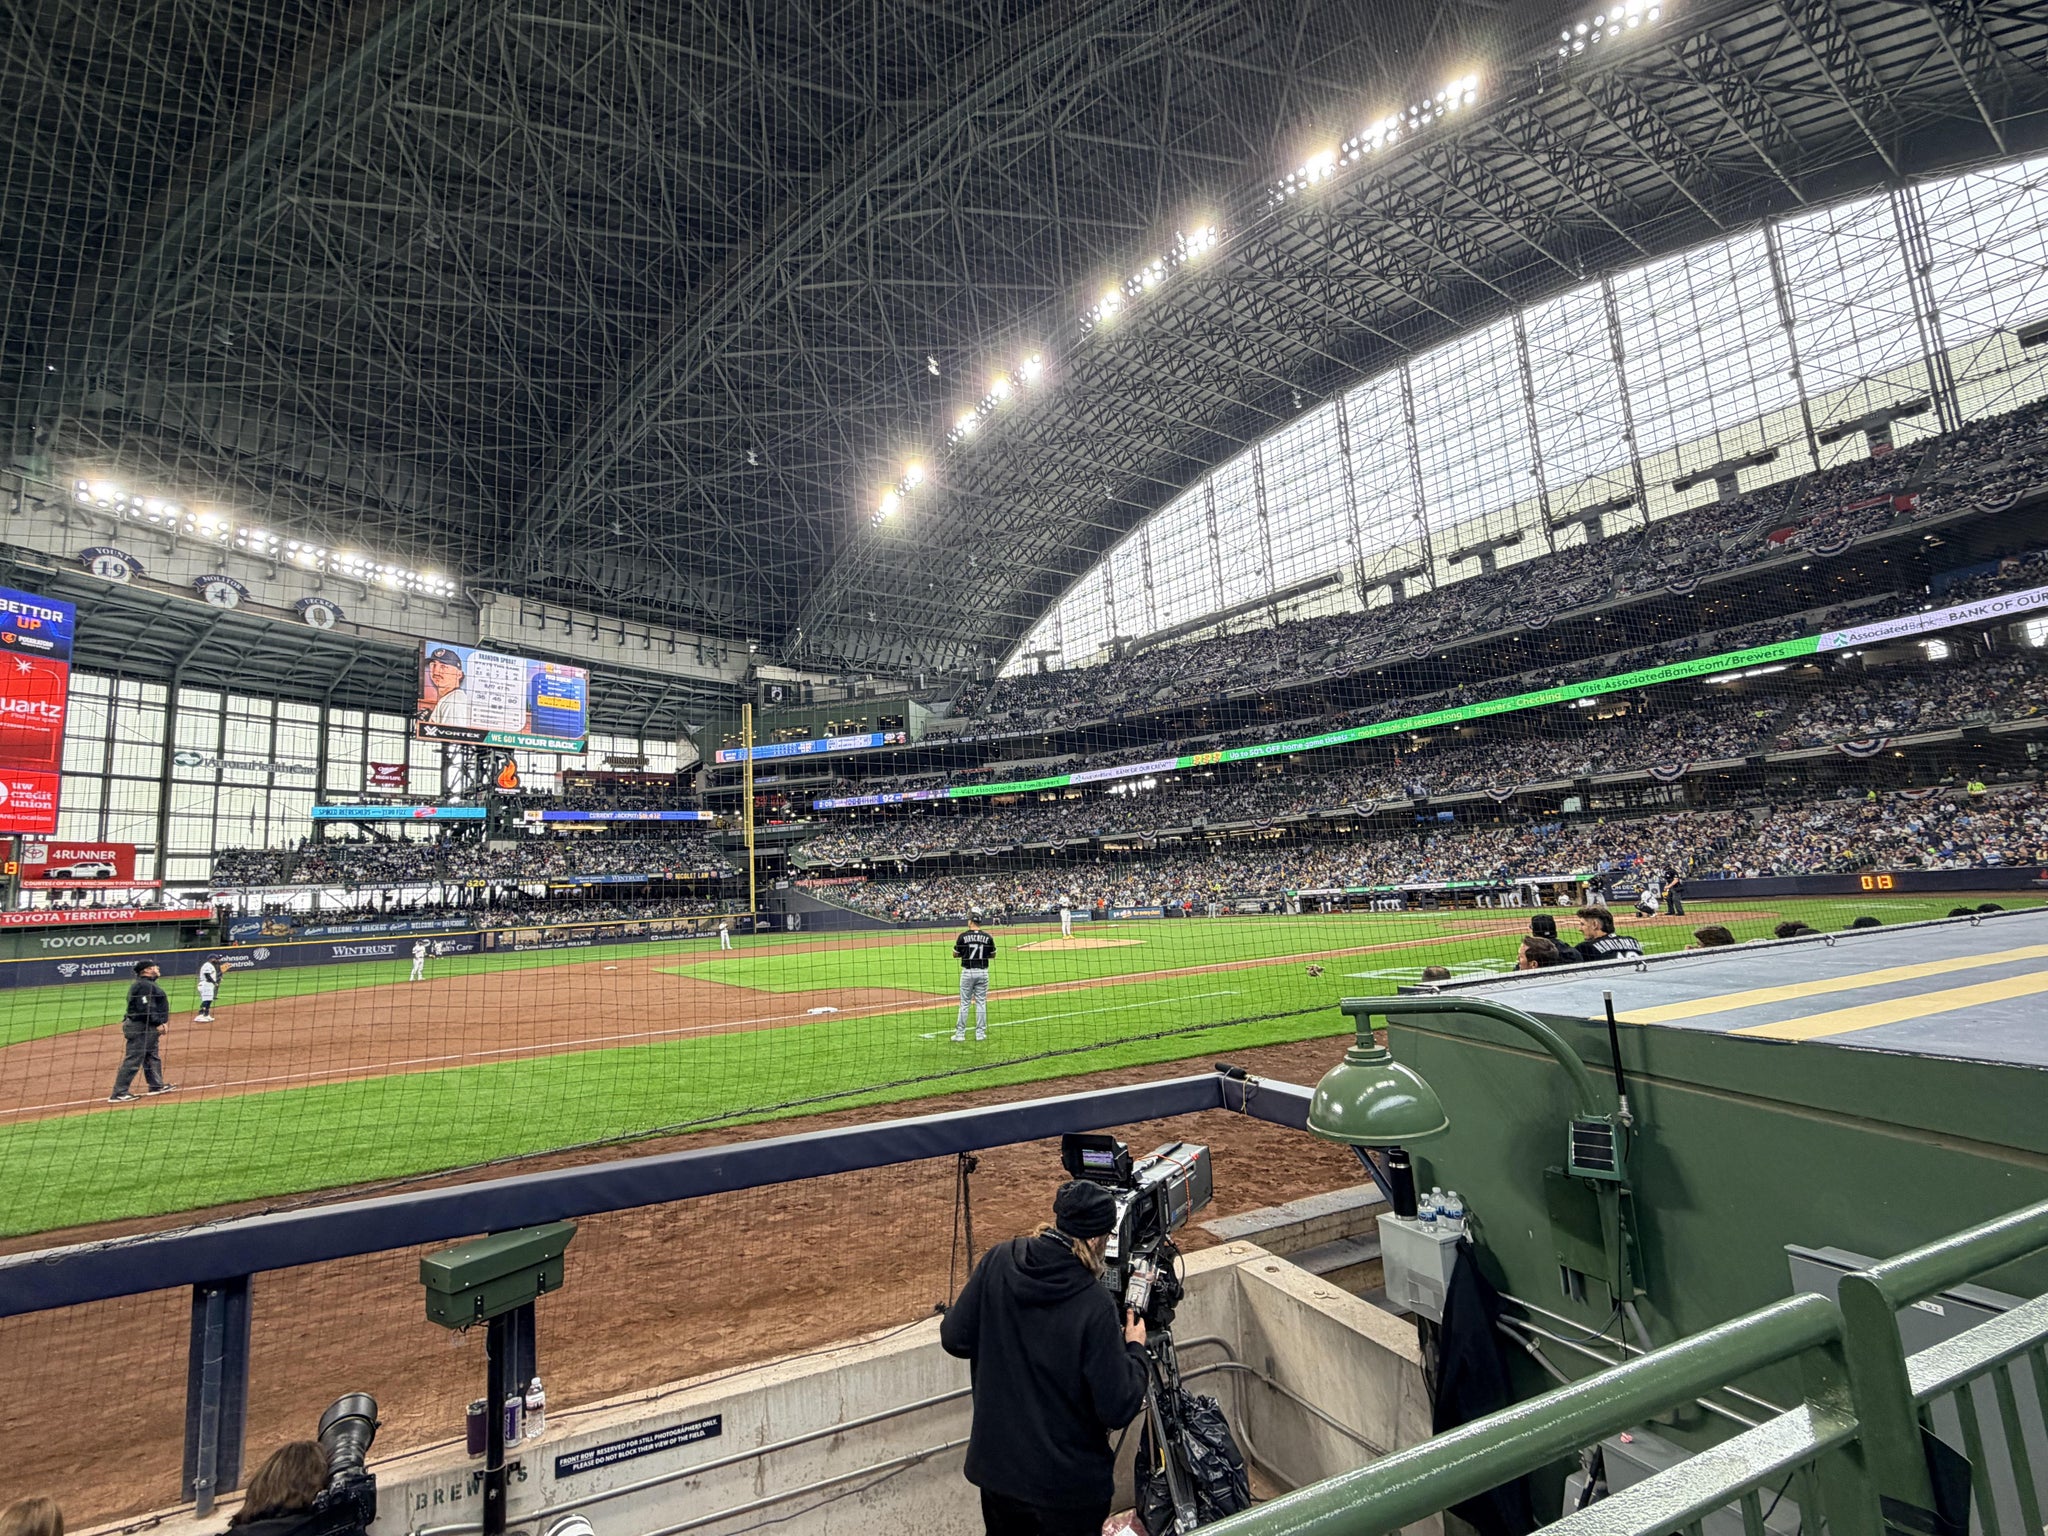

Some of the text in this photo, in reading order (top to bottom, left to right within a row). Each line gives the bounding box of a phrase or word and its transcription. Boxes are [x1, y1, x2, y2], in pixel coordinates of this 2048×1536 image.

[95, 547, 131, 561] YOUNT
[98, 561, 126, 579] 19
[202, 576, 242, 590] MOLITOR
[214, 588, 226, 603] 4
[0, 599, 63, 623] BETTOR
[1849, 591, 2048, 641] AssociatedBank BANK OF OUR
[17, 615, 41, 630] UP
[1577, 647, 1785, 694] Visit AssociatedBank.com/Brewers
[0, 697, 62, 718] uartz
[1475, 692, 1562, 715] Brewers Checking
[438, 730, 480, 739] VORTEX
[491, 734, 502, 743] WE
[517, 737, 547, 747] YOUR
[1229, 751, 1239, 760] Up
[1265, 745, 1280, 753] OFF
[1282, 741, 1303, 751] home
[1305, 738, 1324, 749] game
[1325, 734, 1348, 744] tickets
[1357, 727, 1377, 737] more
[11, 782, 34, 790] uw
[11, 790, 52, 800] credit
[10, 800, 52, 809] union
[52, 849, 116, 860] 4RUNNER
[4, 861, 18, 875] 13
[466, 878, 518, 887] 620 WTMJ
[4, 910, 137, 923] TOYOTA TERRITORY
[40, 933, 150, 948] TOYOTA.COM
[332, 945, 396, 957] WINTRUST
[969, 944, 984, 959] 71
[81, 960, 139, 970] Northwester
[81, 968, 114, 977] Mutual
[560, 1419, 718, 1465] FRONT ROW RESERVED FOR STILL PHOTOGRAPHERS ONLY.
[572, 1460, 595, 1470] PLEASE
[605, 1454, 618, 1462] NOT
[618, 1449, 637, 1459] BLOCK
[637, 1444, 654, 1454] THEIR
[654, 1440, 669, 1449] VIEW
[669, 1438, 678, 1446] OF
[678, 1434, 688, 1443] THE
